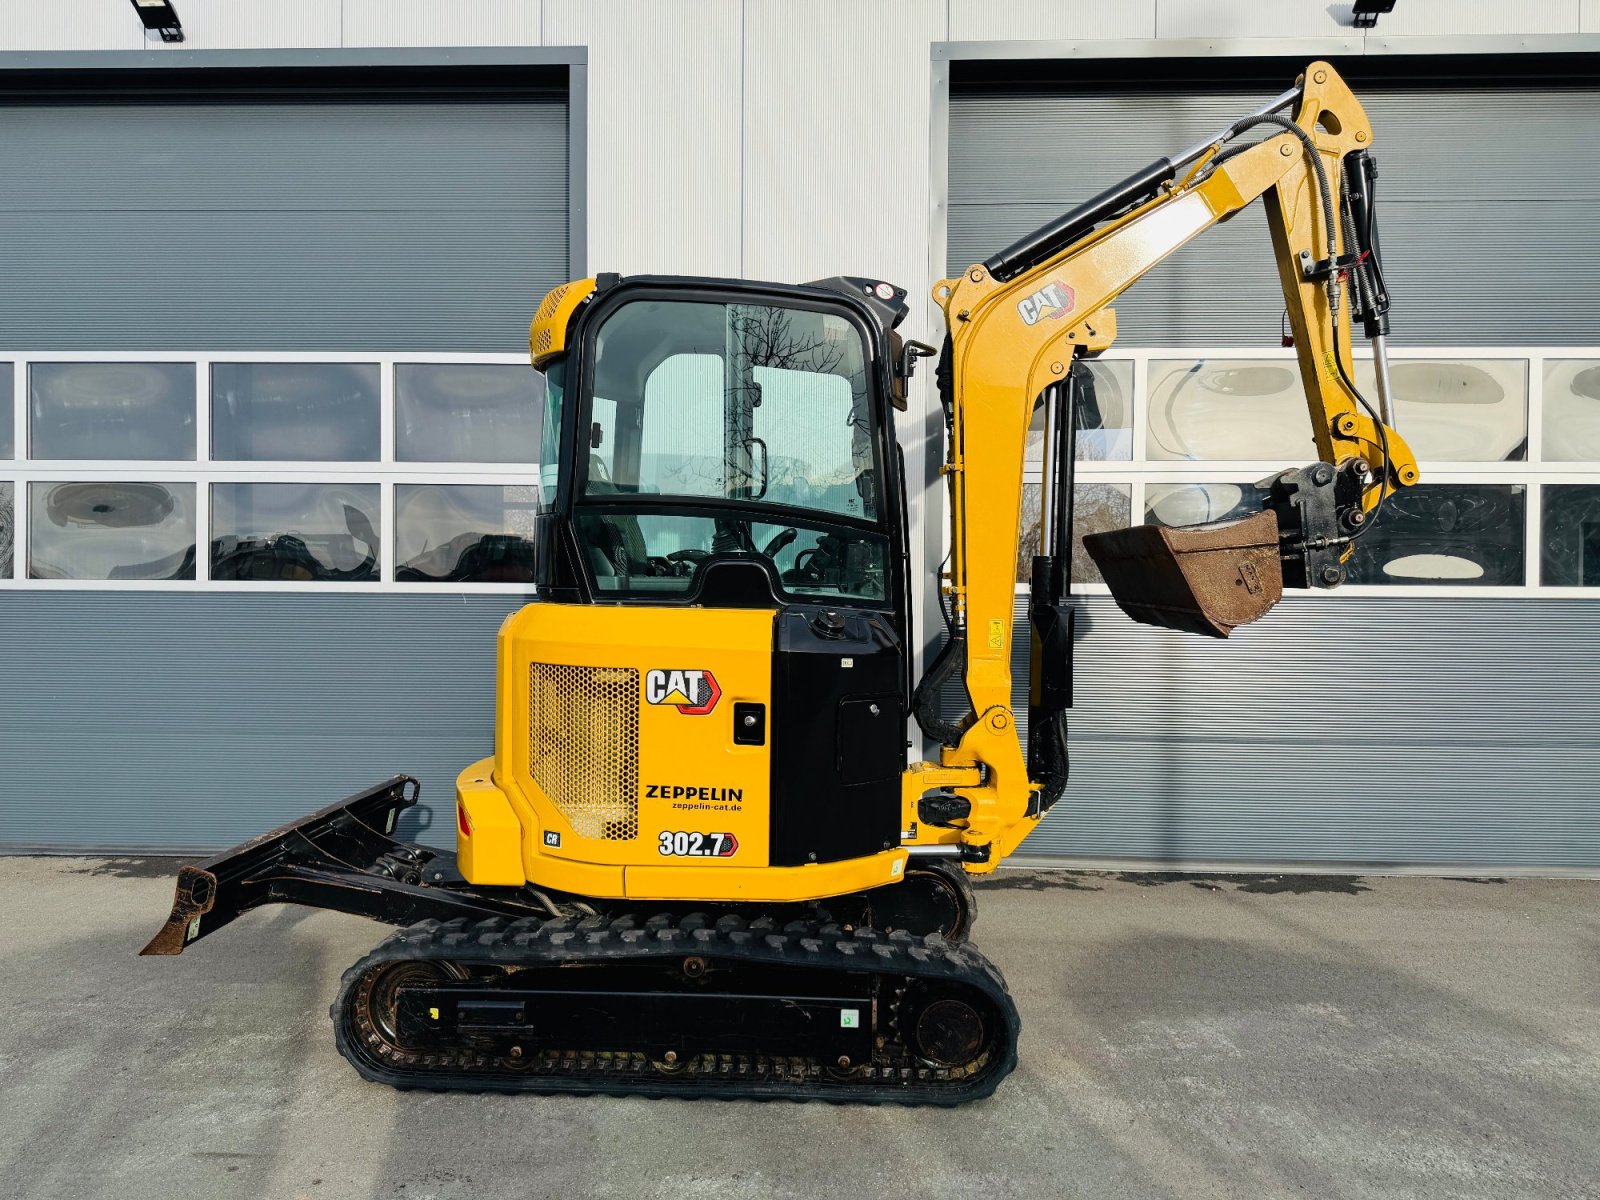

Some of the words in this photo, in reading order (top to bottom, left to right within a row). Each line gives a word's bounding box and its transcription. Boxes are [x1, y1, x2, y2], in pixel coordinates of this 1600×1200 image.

[1018, 283, 1062, 324] CAT
[646, 670, 703, 704] CAT
[645, 785, 743, 802] ZEPPELIN
[672, 803, 742, 811] zeppelin-cat.de
[547, 833, 558, 845] CR
[659, 831, 725, 856] 302.7
